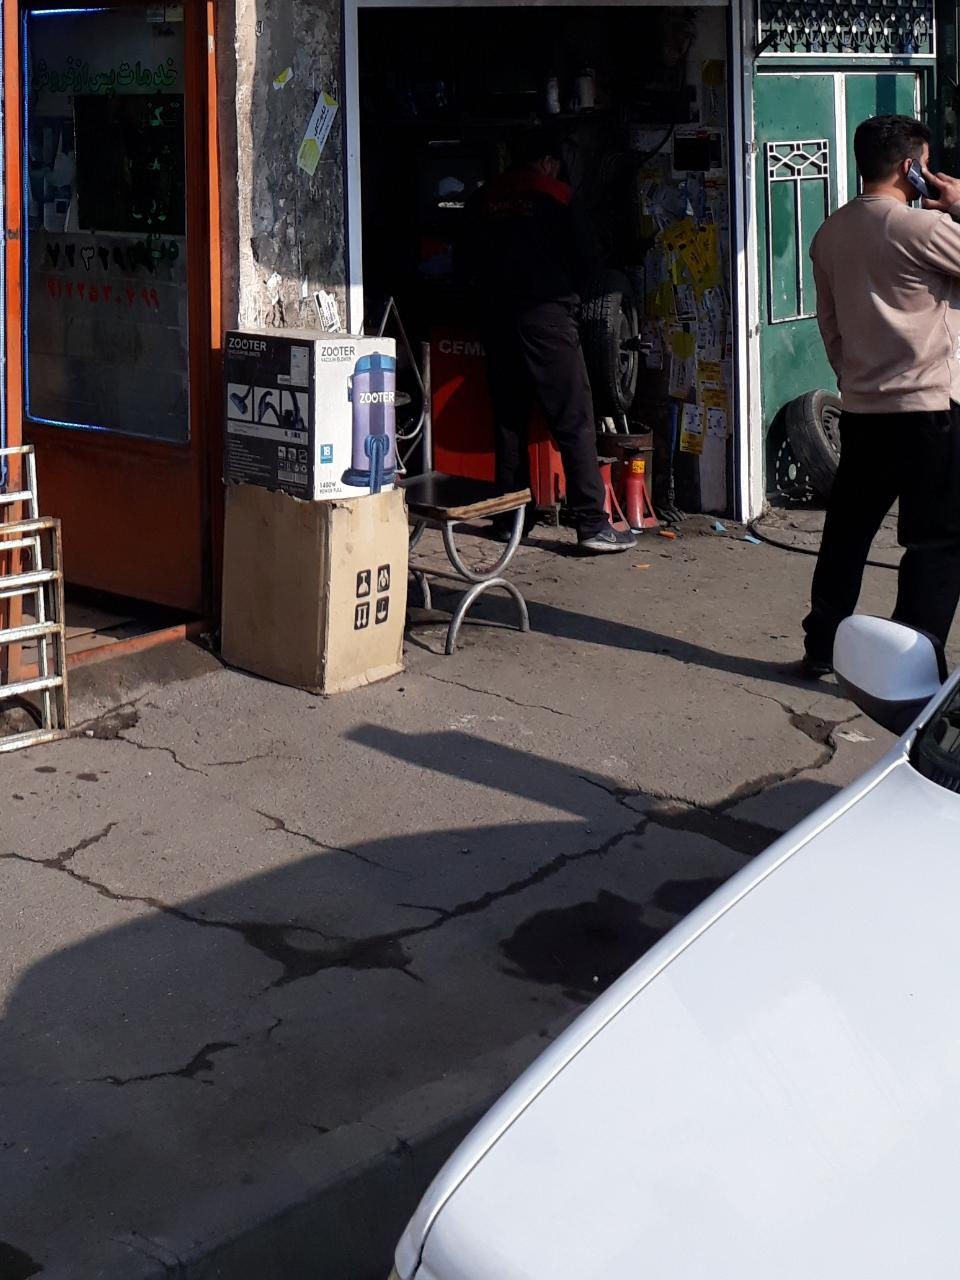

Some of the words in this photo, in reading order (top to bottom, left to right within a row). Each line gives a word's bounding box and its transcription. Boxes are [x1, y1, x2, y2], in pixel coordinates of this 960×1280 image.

[228, 337, 267, 352] ZOOTER
[321, 346, 355, 357] ZOOTER
[359, 391, 395, 404] ZOOTER
